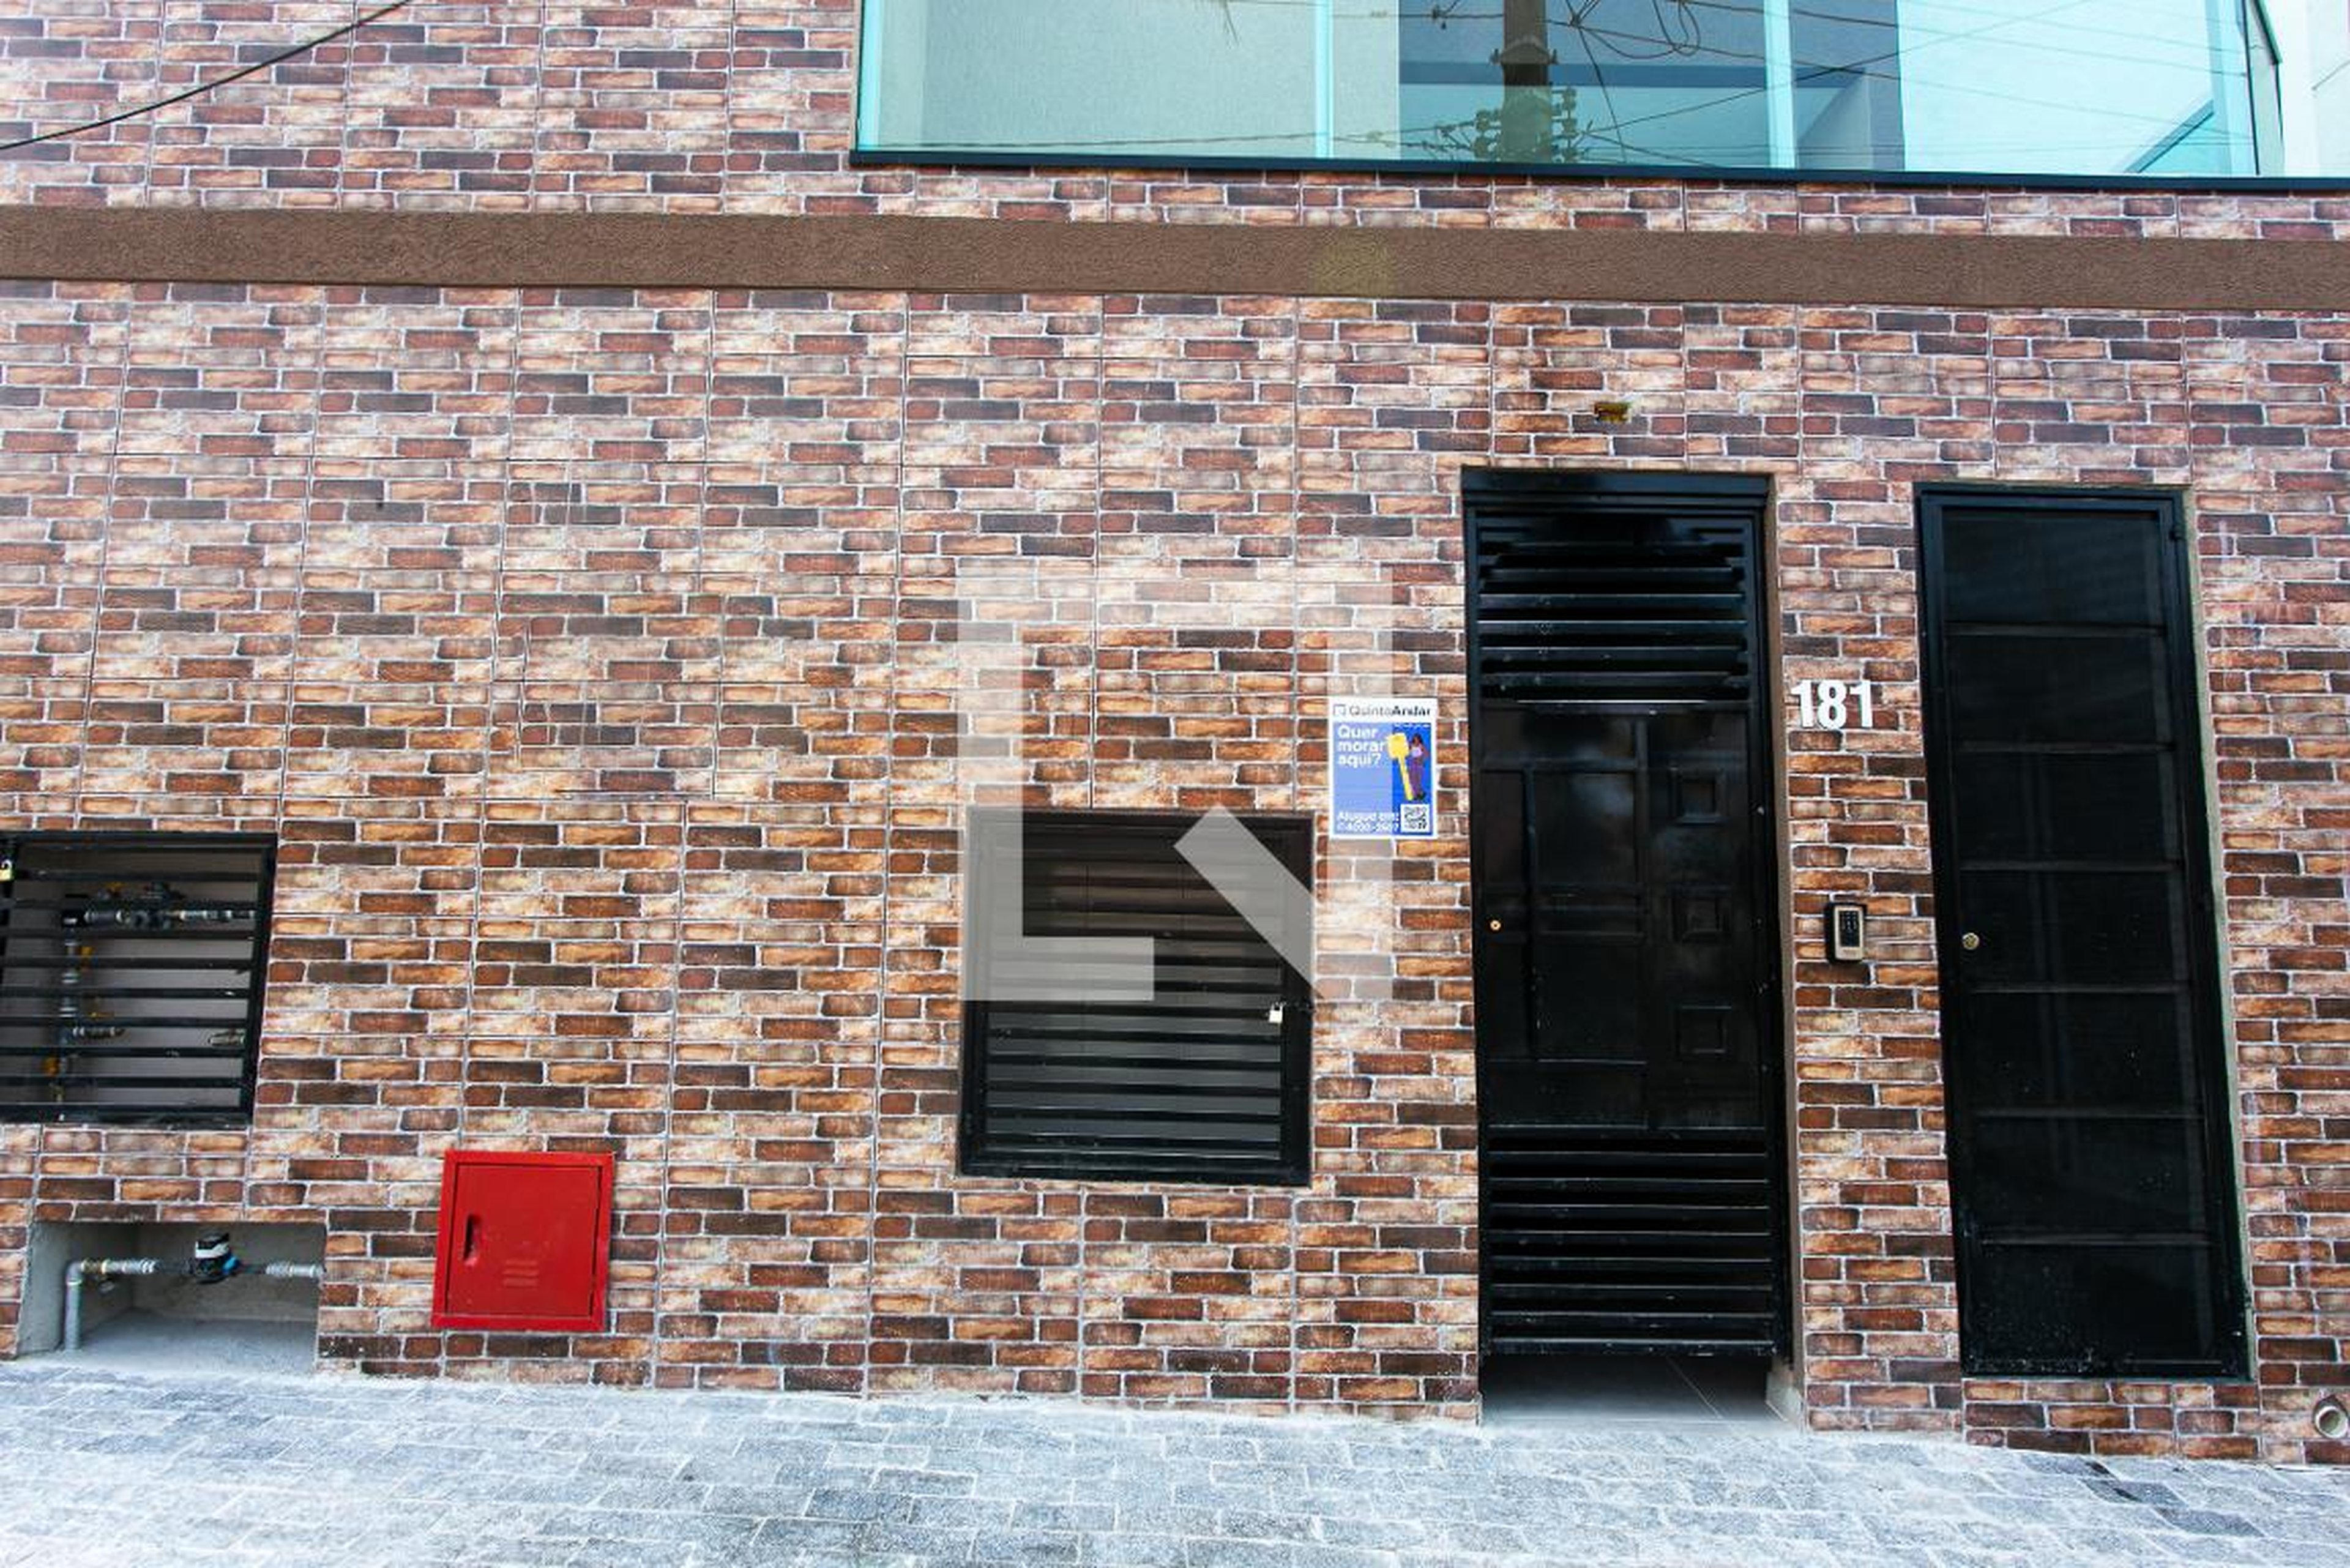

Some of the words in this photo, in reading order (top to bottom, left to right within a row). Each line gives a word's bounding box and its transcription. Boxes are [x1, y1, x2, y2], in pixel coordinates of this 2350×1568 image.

[1349, 705, 1431, 716] QuintoAndar
[1791, 679, 1873, 729] 181
[1338, 725, 1378, 738] Quer
[1338, 741, 1385, 752] morar
[1338, 753, 1381, 767] aqui?
